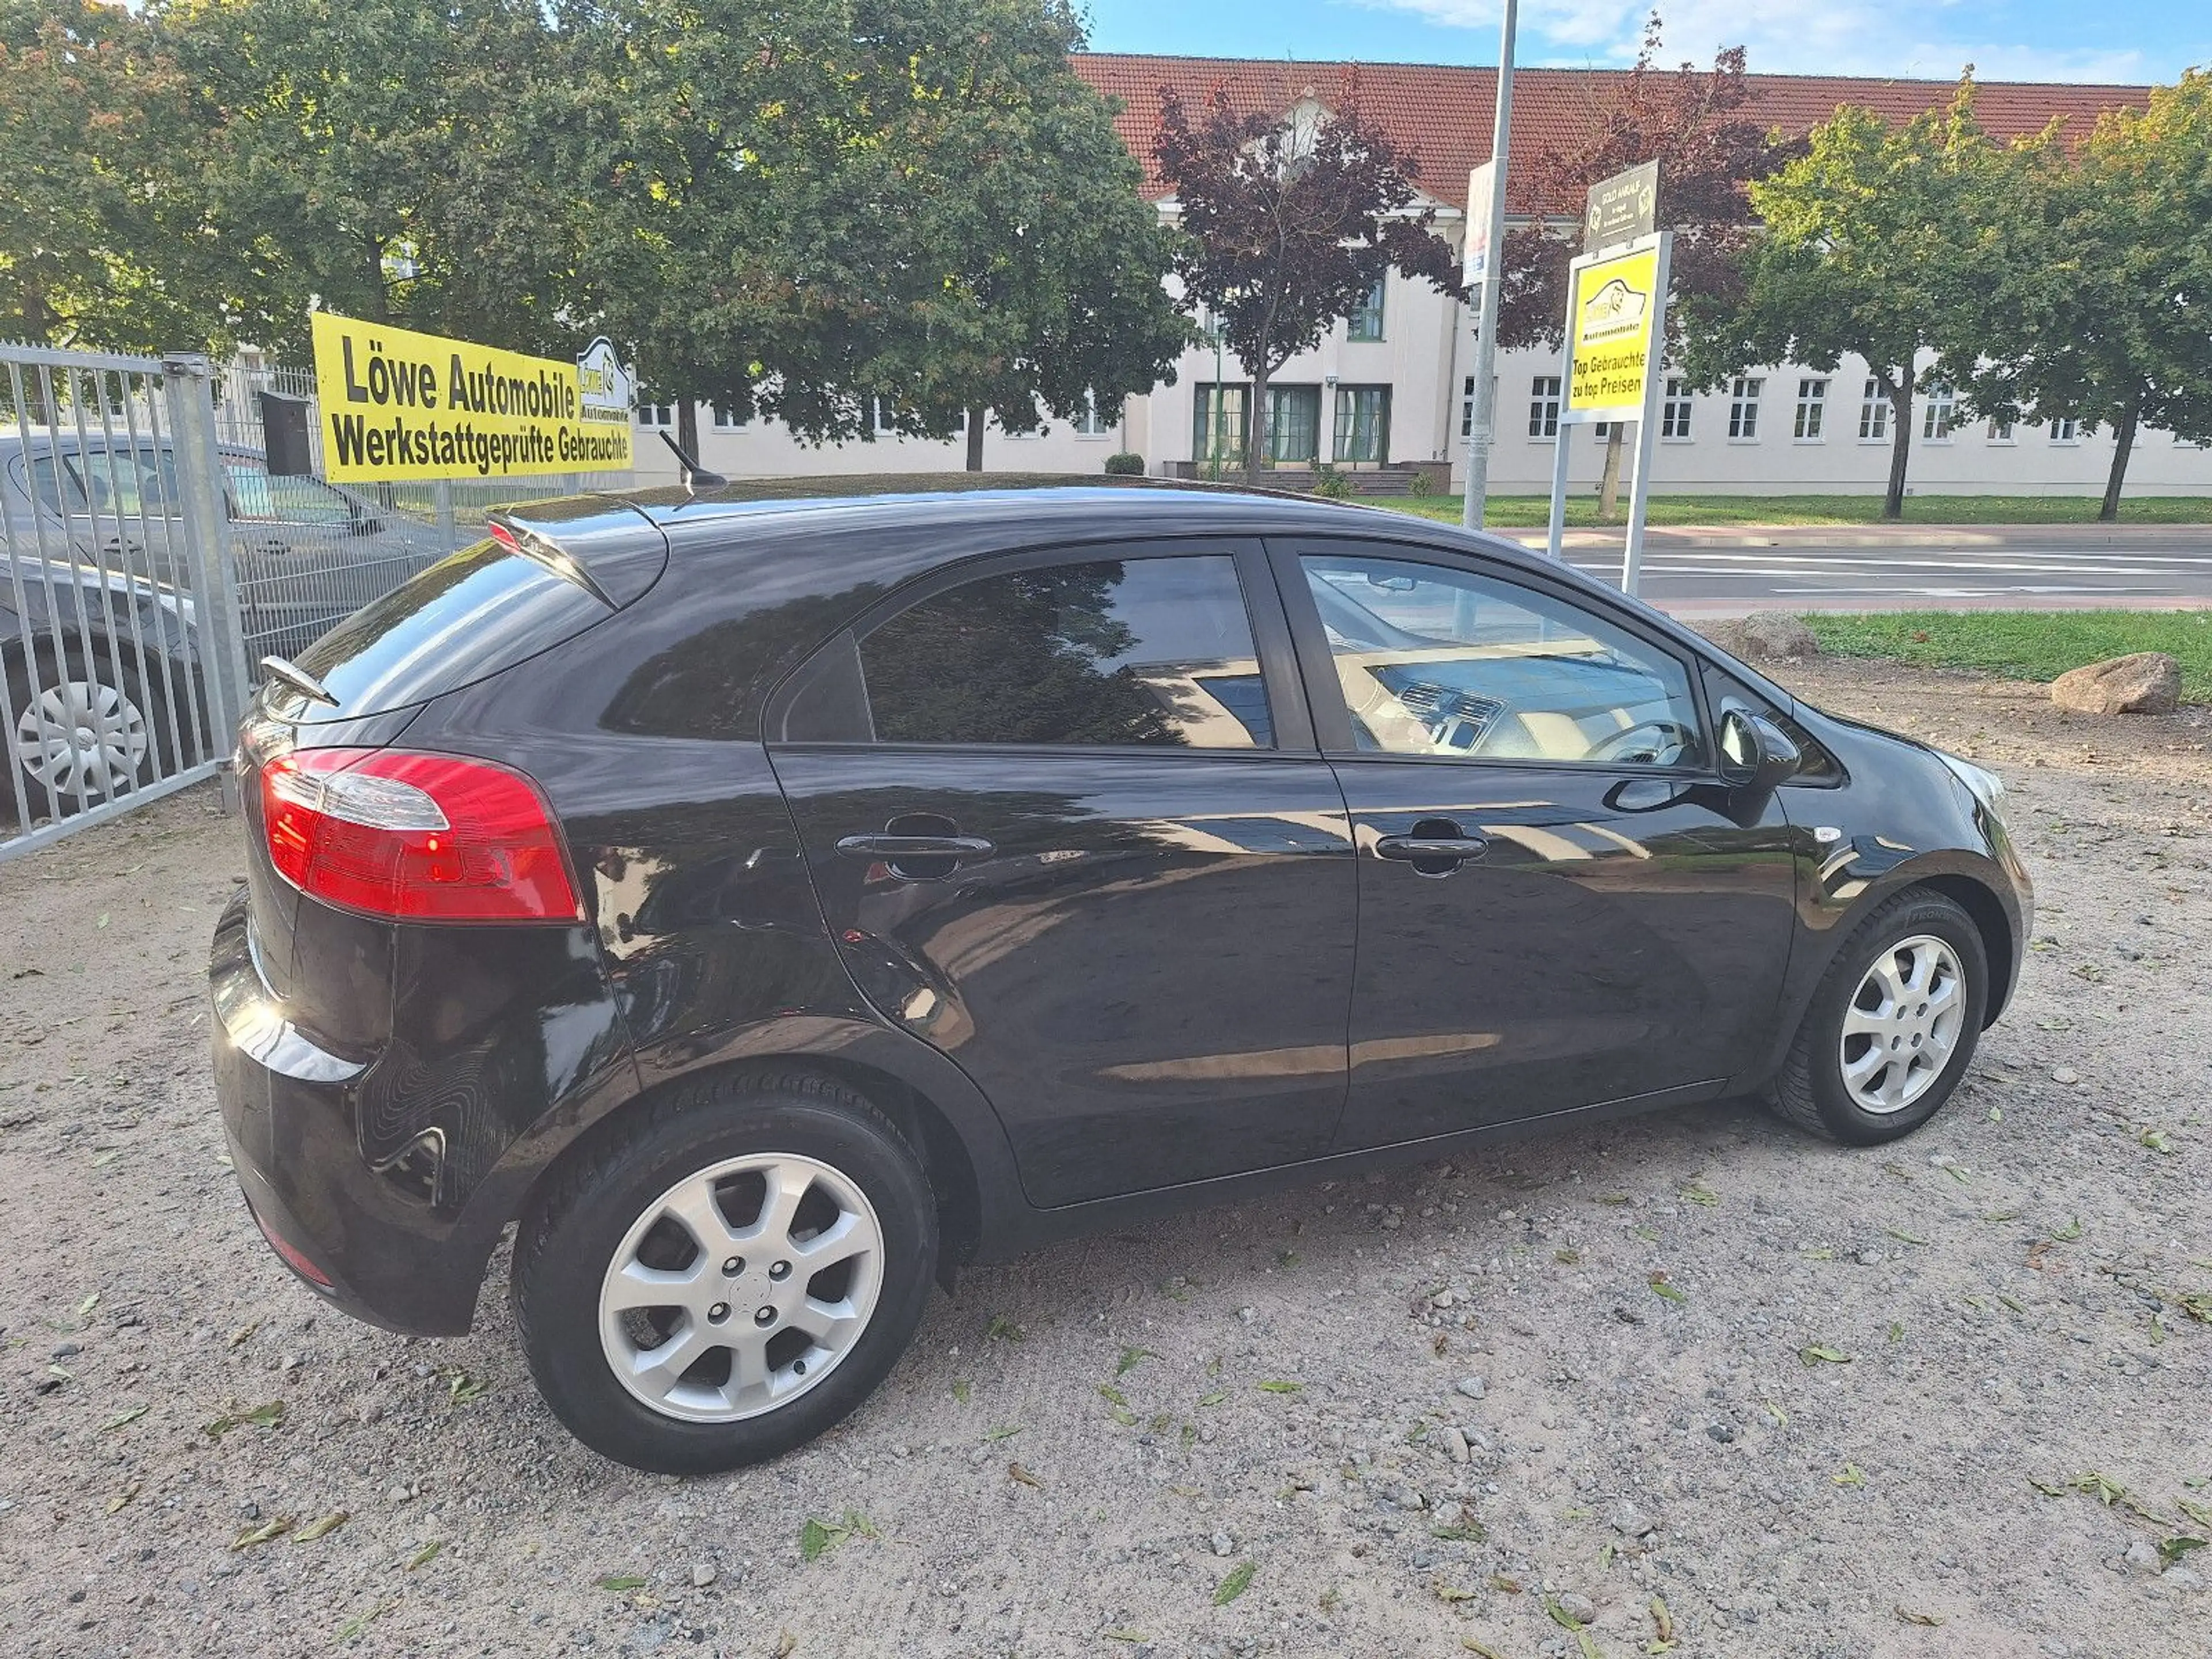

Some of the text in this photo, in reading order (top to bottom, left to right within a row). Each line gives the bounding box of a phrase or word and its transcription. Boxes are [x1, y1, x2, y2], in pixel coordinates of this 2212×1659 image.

[342, 335, 575, 420] Löwe Automobile
[1573, 351, 1645, 378] Top Gebrauchte
[1573, 375, 1641, 399] zu top Preisen
[331, 413, 627, 475] Werkstattgeprüfte Gebrauchte
